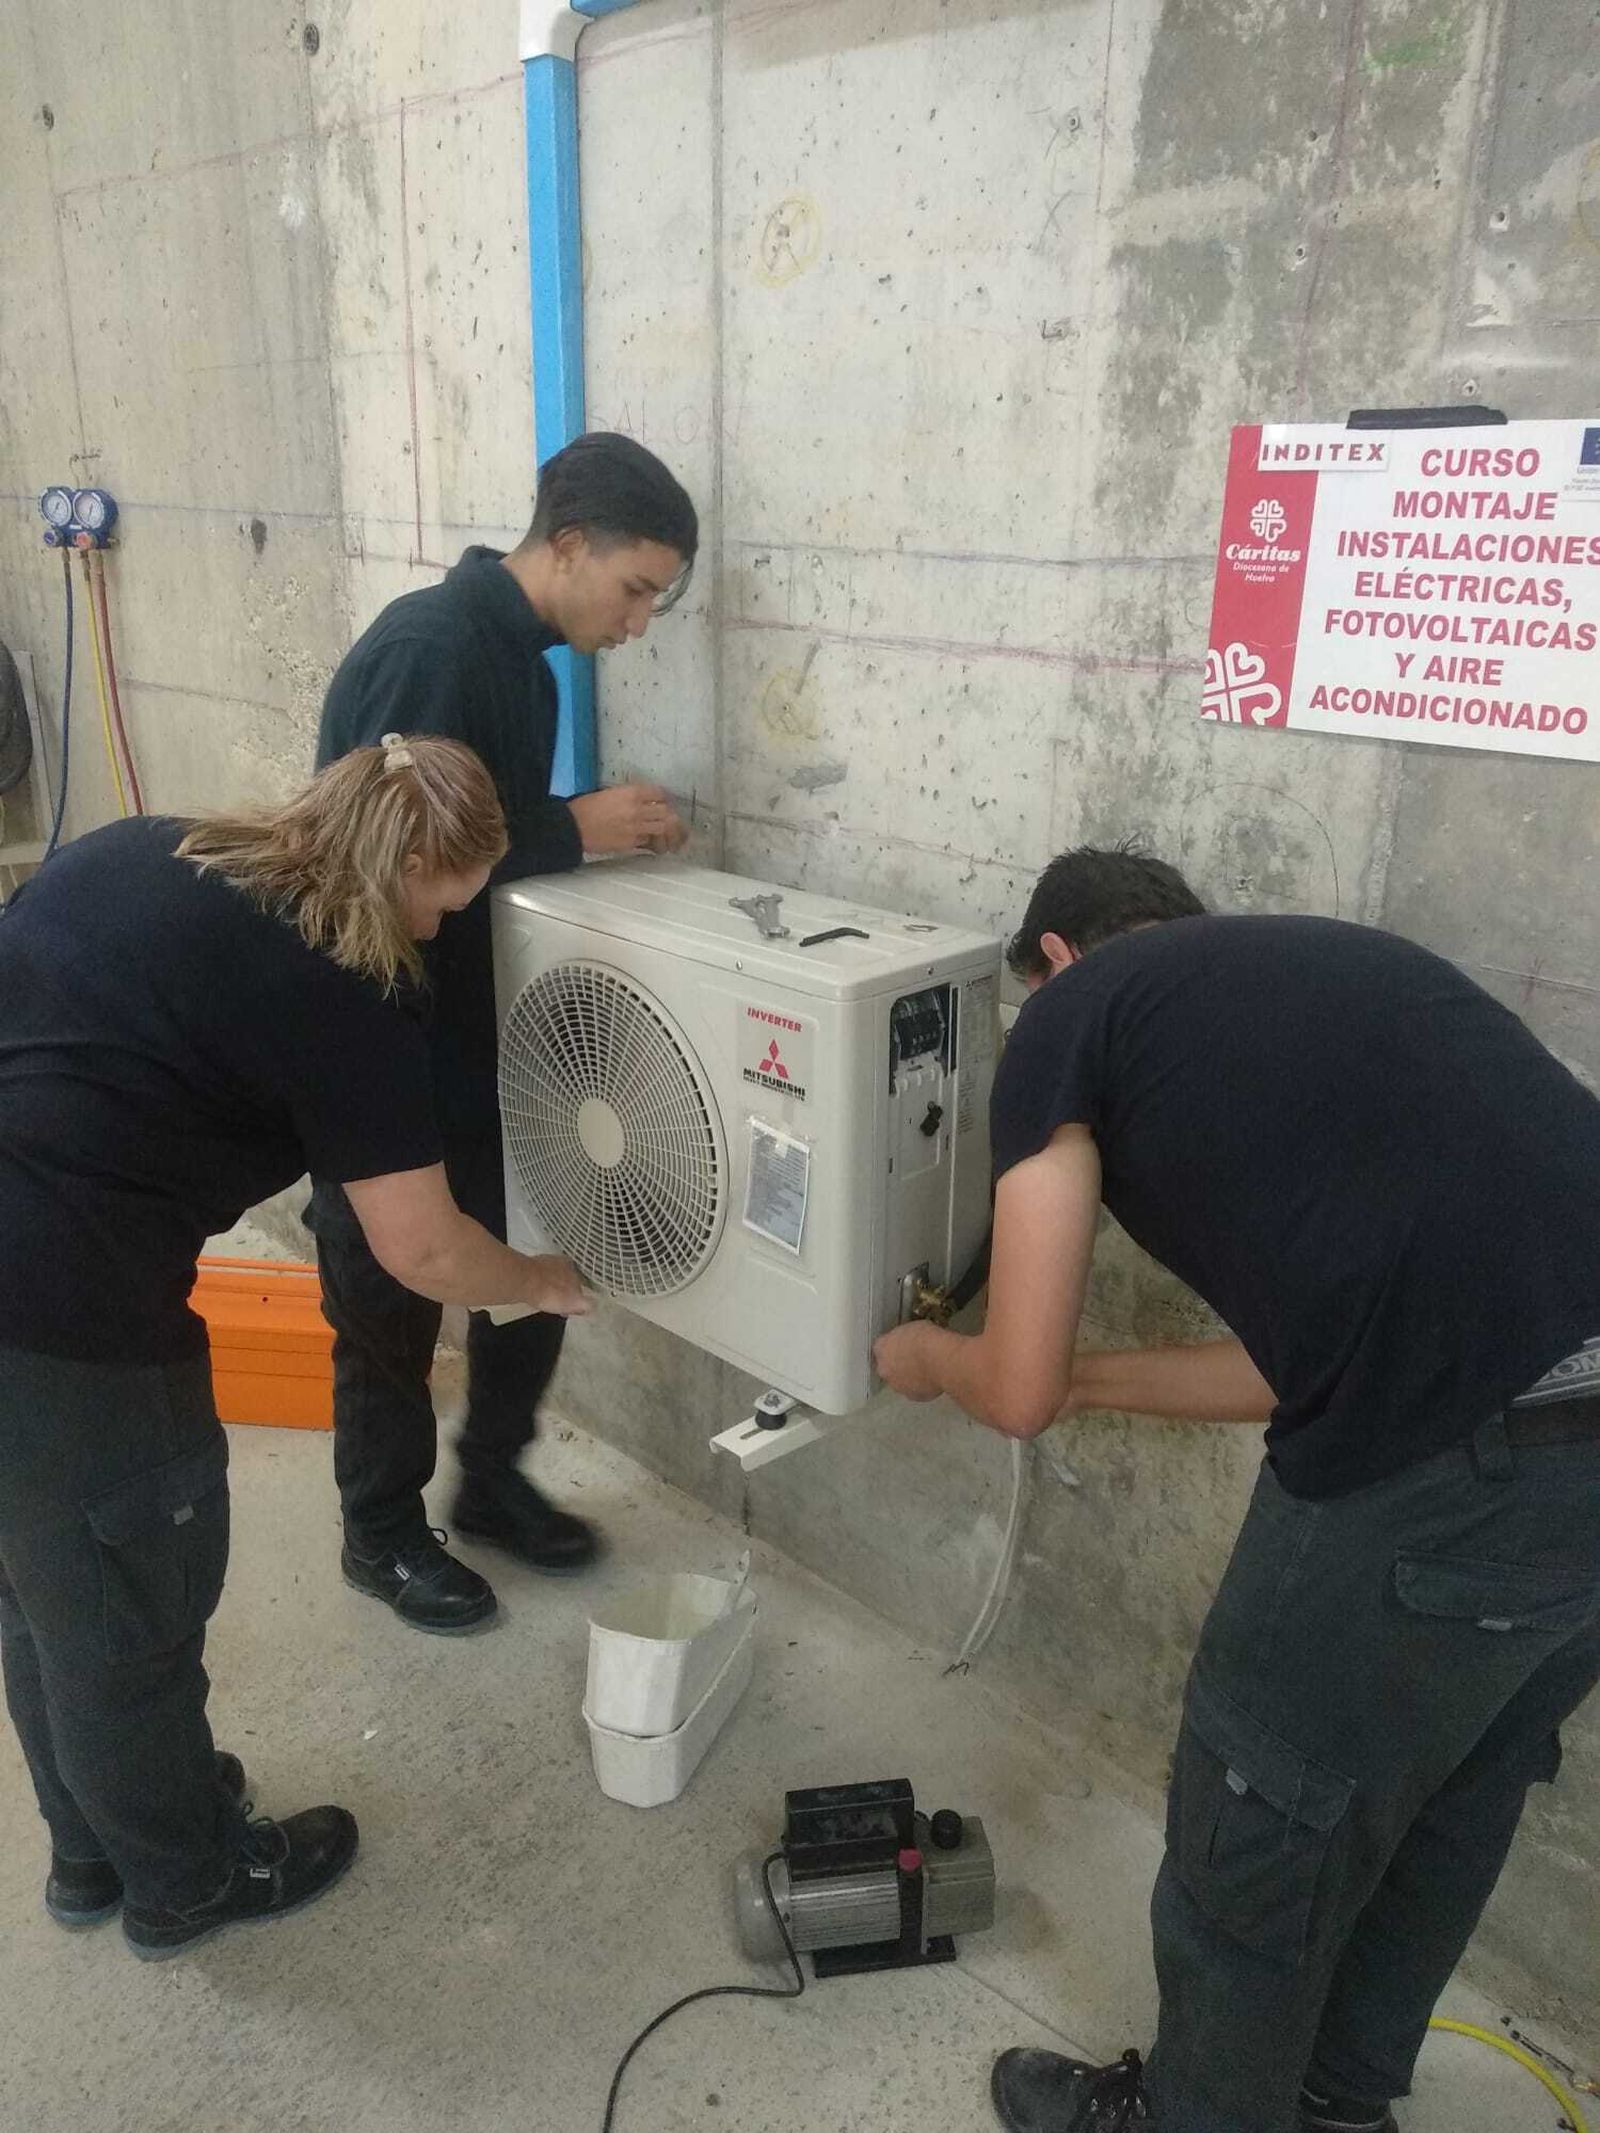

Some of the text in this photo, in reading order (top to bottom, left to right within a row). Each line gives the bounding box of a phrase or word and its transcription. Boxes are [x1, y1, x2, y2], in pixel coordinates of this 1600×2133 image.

[1262, 443, 1385, 461] INDITEX
[1420, 448, 1541, 477] CURSO
[1393, 491, 1558, 521] MONTAJE
[1226, 543, 1301, 562] Cáritas
[1337, 531, 1600, 565] INSTALACIONES
[1354, 567, 1573, 613] ELÉCTRICAS,
[1325, 609, 1597, 651] FOTOVOLTAICAS
[1395, 653, 1504, 686] Y AIRE
[1309, 685, 1588, 735] ACONDICIONADO
[747, 1006, 802, 1032] INVERTER
[743, 1067, 805, 1097] MITSUBISHI
